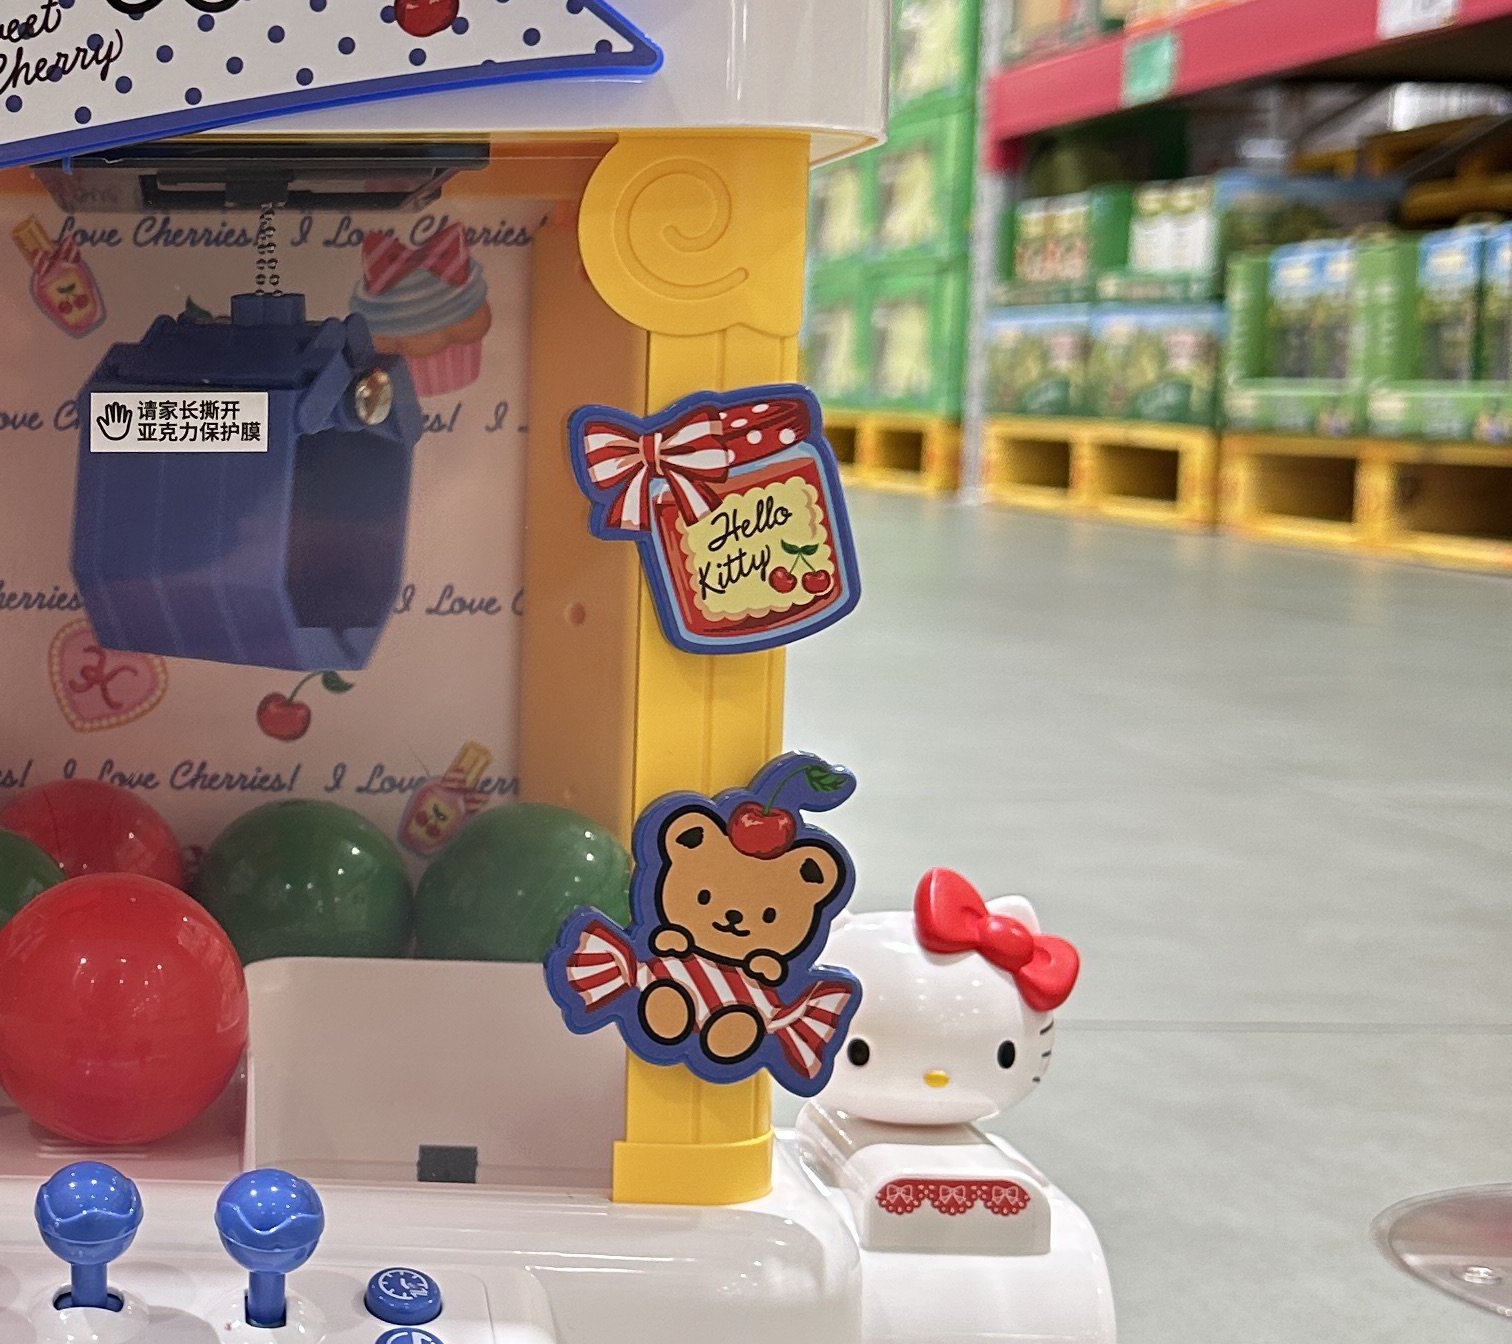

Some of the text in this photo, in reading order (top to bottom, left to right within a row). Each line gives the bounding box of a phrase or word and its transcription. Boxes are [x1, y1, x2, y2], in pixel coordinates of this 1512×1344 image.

[137, 400, 240, 421] 请家长撕开
[137, 421, 261, 442] 亚克力保护膜
[707, 495, 792, 551] Hello
[698, 544, 771, 600] Kitty
[425, 584, 501, 616] Love
[170, 761, 301, 793] Cherries!
